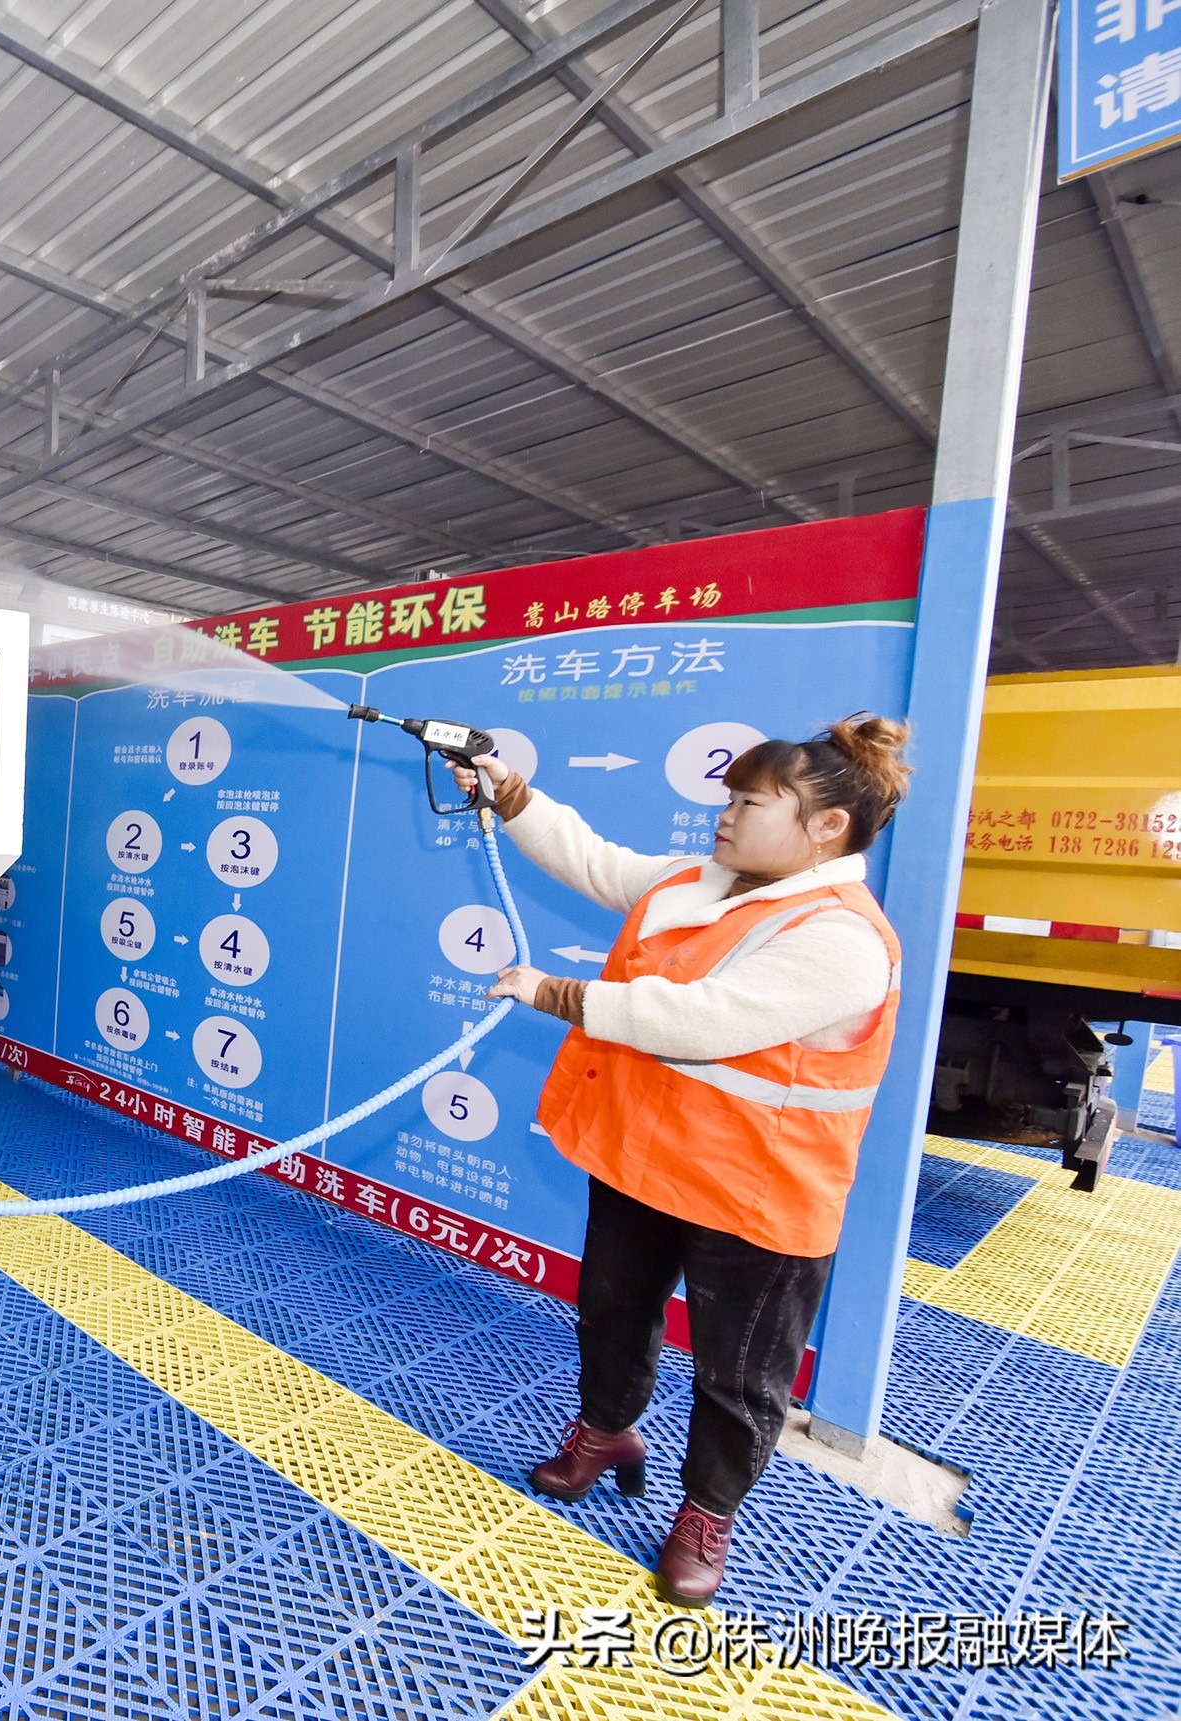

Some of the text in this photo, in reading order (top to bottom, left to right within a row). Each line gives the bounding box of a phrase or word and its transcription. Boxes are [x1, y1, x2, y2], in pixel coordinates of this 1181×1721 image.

[1094, 47, 1181, 129] 请
[303, 585, 487, 651] 节能环保
[523, 582, 722, 629] 嵩山路停车场
[500, 638, 726, 685] 洗车方法
[146, 680, 256, 709] 洗车流程
[518, 680, 698, 703] 按照页面提示操作
[189, 731, 201, 759] 1
[179, 761, 215, 771] 登录账号
[704, 748, 733, 779] 2
[124, 823, 142, 850] 2
[230, 830, 251, 860] 3
[1049, 836, 1081, 854] 138
[1092, 837, 1139, 857] 7286
[118, 851, 149, 862] 按清水键
[220, 864, 260, 877] 按泡沫键
[118, 911, 135, 938] 5
[111, 936, 142, 950] 按吸尘键
[220, 930, 241, 959] 4
[464, 927, 485, 953] 4
[213, 960, 253, 977] 按清水键
[113, 1000, 130, 1027] 6
[106, 1025, 137, 1041] 按杀毒键
[217, 1029, 238, 1059] 7
[210, 1059, 239, 1075] 按结算
[449, 1094, 468, 1121] 5
[394, 1160, 509, 1211] 带电物体进行喷射
